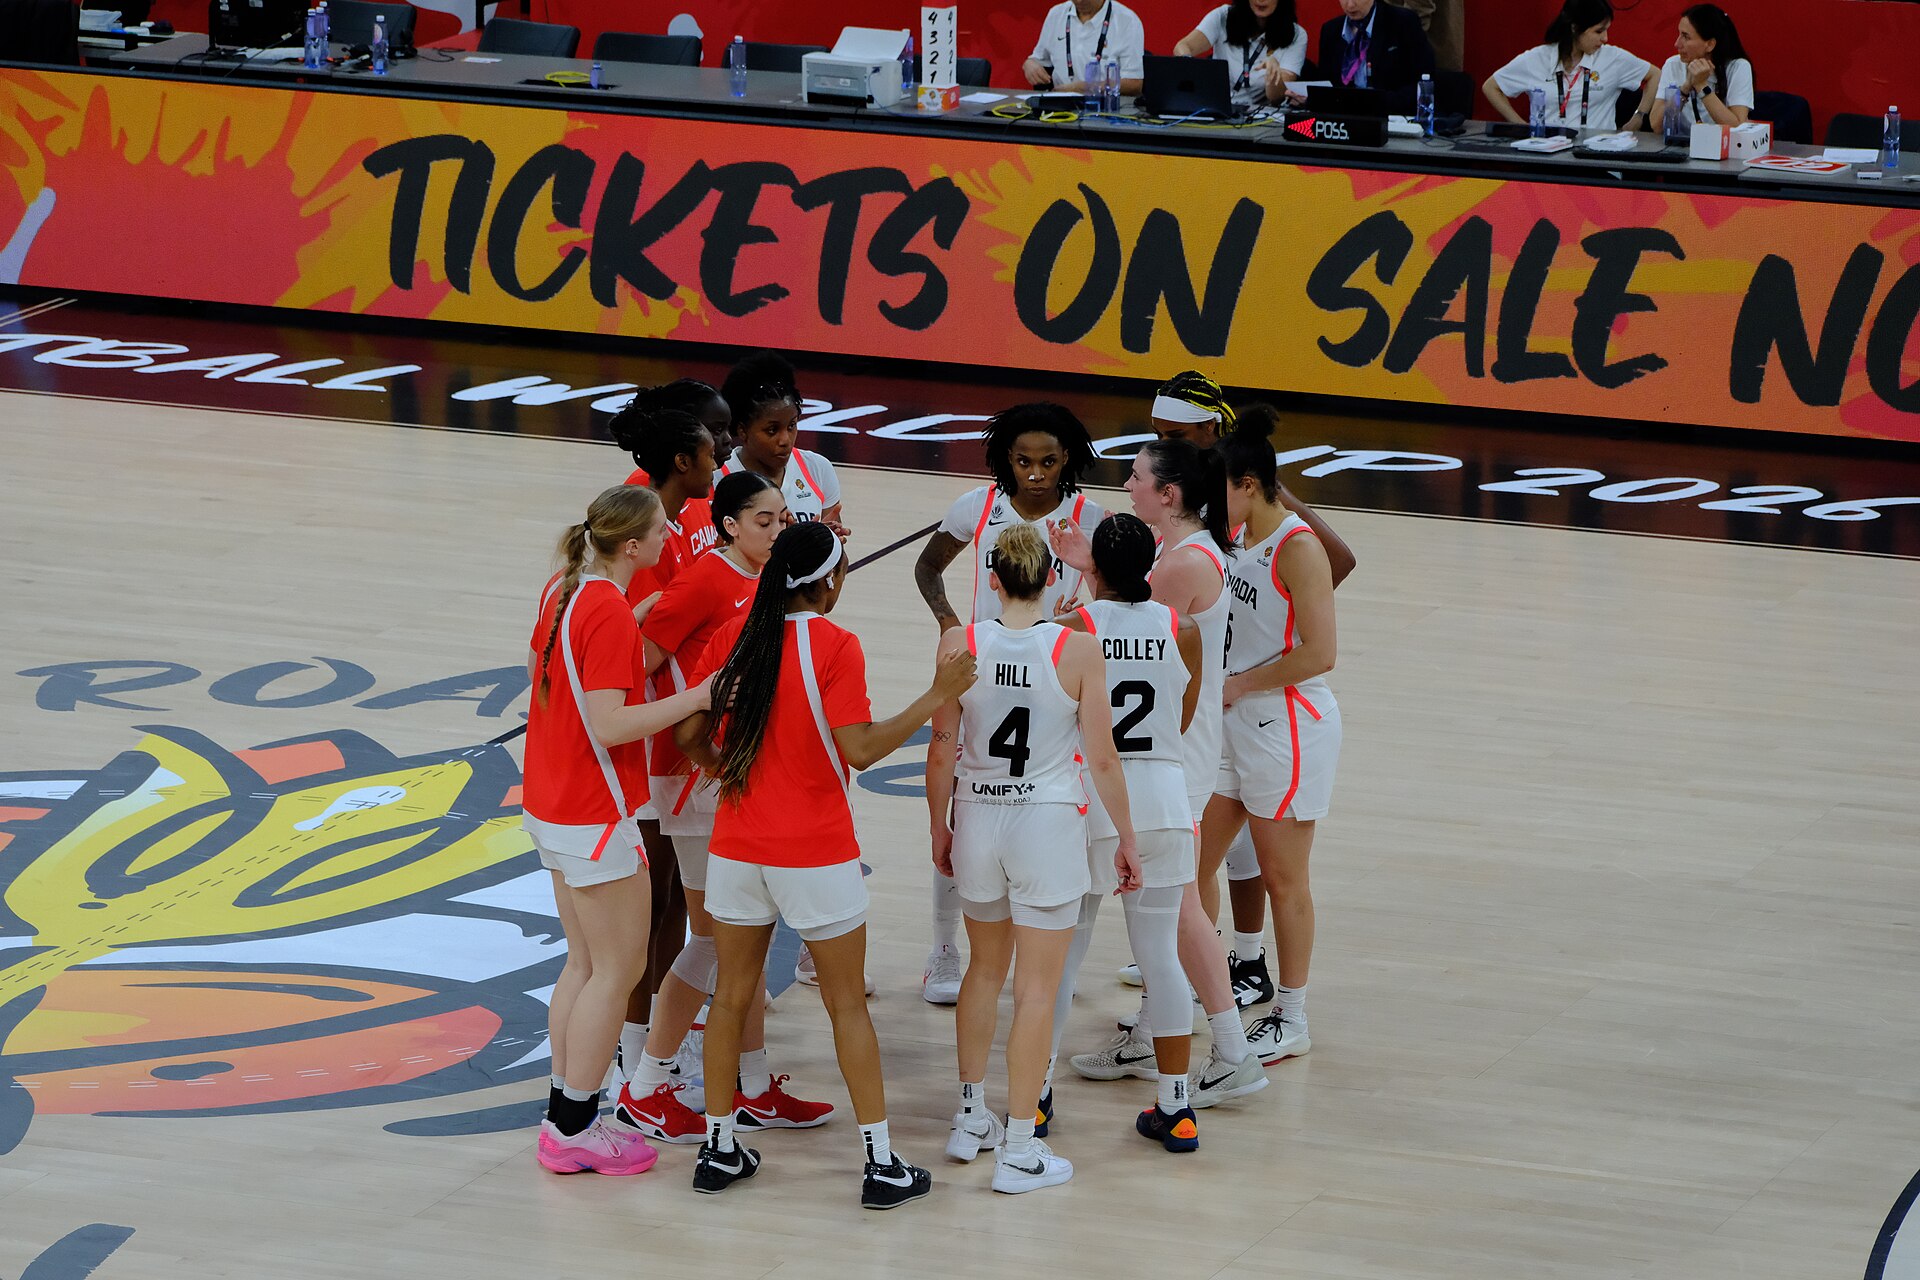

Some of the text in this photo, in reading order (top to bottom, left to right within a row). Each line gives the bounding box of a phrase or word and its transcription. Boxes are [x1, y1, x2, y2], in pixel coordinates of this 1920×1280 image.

[928, 11, 938, 25] 4
[929, 31, 938, 45] 3
[929, 50, 939, 65] 2
[930, 70, 937, 84] 1
[363, 134, 970, 331] TICKETS
[1014, 182, 1264, 357] ON
[1307, 210, 1686, 389] SALE
[1478, 467, 1920, 521] 2026
[1102, 638, 1166, 661] COLLEY
[995, 663, 1031, 688] HILL
[1110, 680, 1155, 753] 2
[988, 706, 1031, 778] 4
